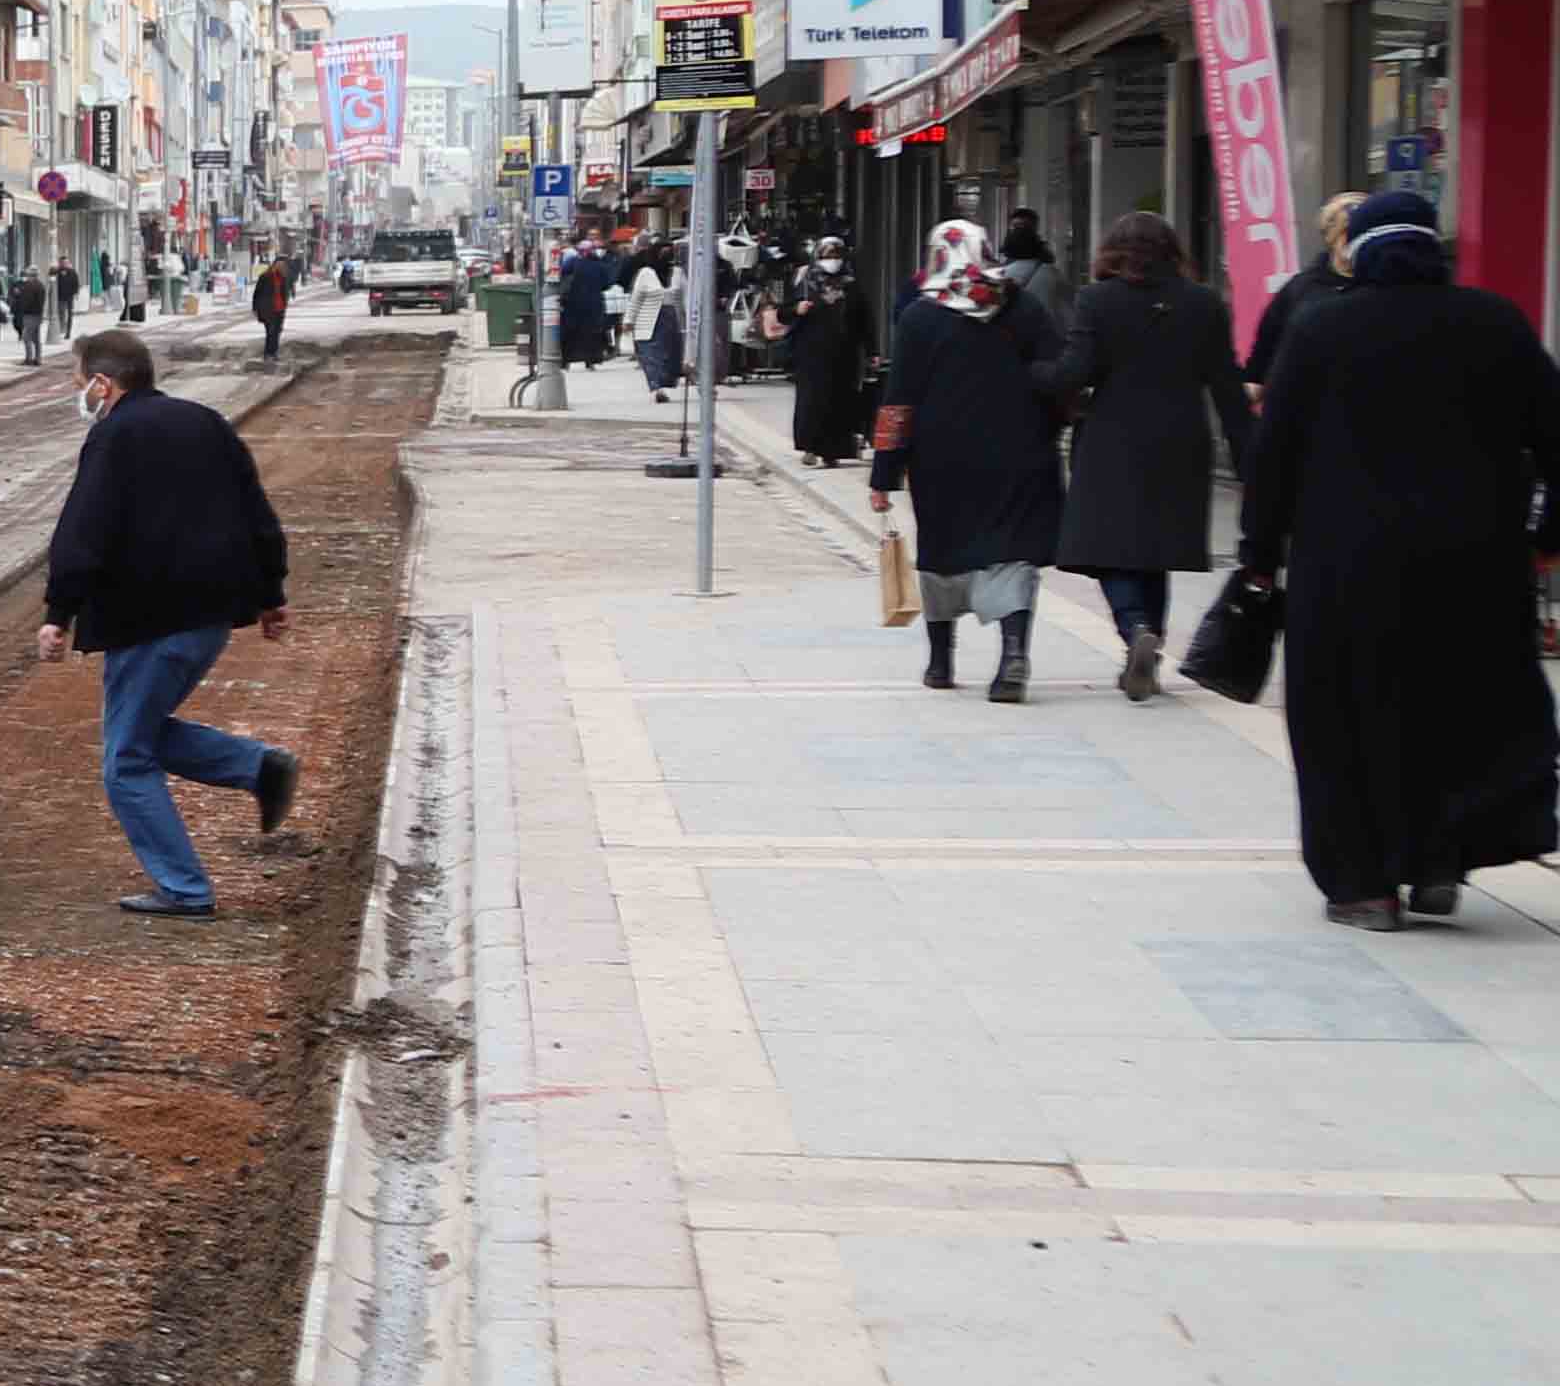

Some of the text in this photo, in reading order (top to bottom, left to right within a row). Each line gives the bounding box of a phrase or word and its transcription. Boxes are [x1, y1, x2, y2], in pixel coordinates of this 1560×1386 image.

[805, 24, 929, 44] Türk Telekom
[544, 170, 562, 192] P
